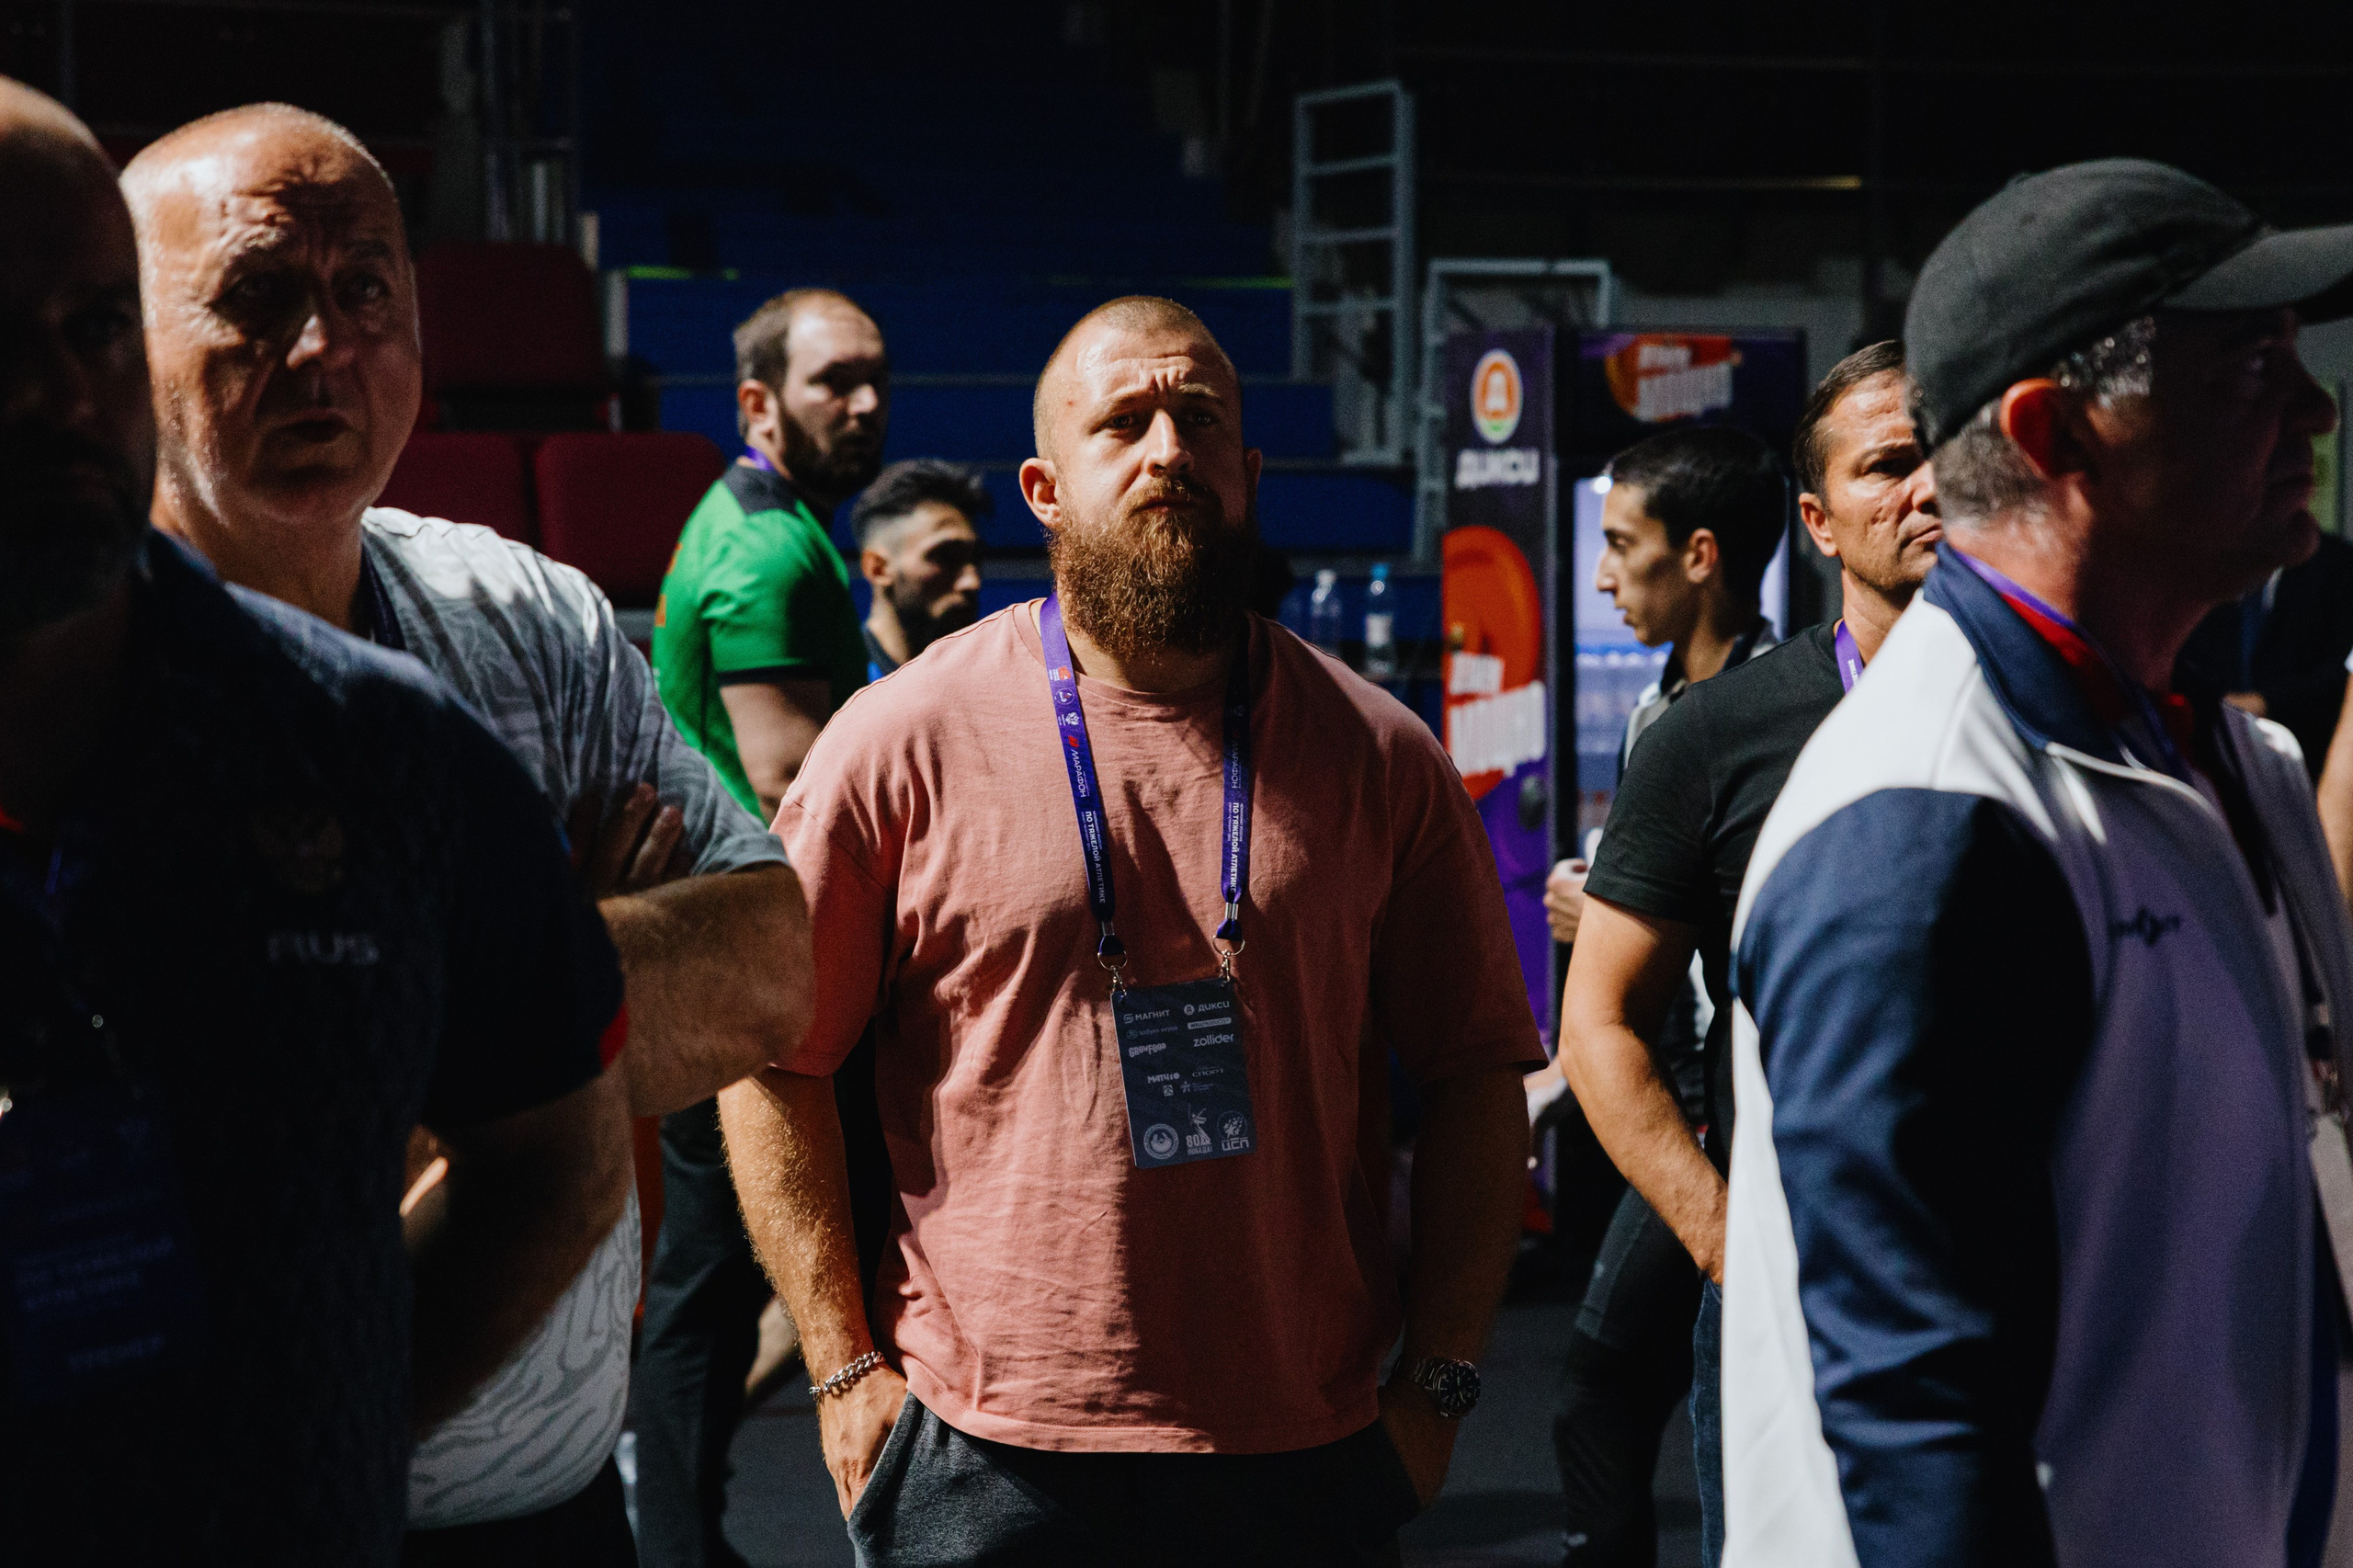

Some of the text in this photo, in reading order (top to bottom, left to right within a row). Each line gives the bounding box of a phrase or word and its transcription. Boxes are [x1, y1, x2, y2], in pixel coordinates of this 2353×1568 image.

[1071, 749, 1086, 798] МАРАФОН
[1233, 802, 1239, 813] ПО
[1086, 811, 1093, 823] ПО
[1087, 823, 1101, 862] ТЯЖЕЛОЙ
[1230, 854, 1238, 892] АТЛЕТИКЕ
[1135, 1010, 1170, 1020] МАГНИТ
[1193, 1033, 1234, 1047] zollider
[1192, 1068, 1224, 1077] СПОРТ
[1186, 1134, 1200, 1147] 80
